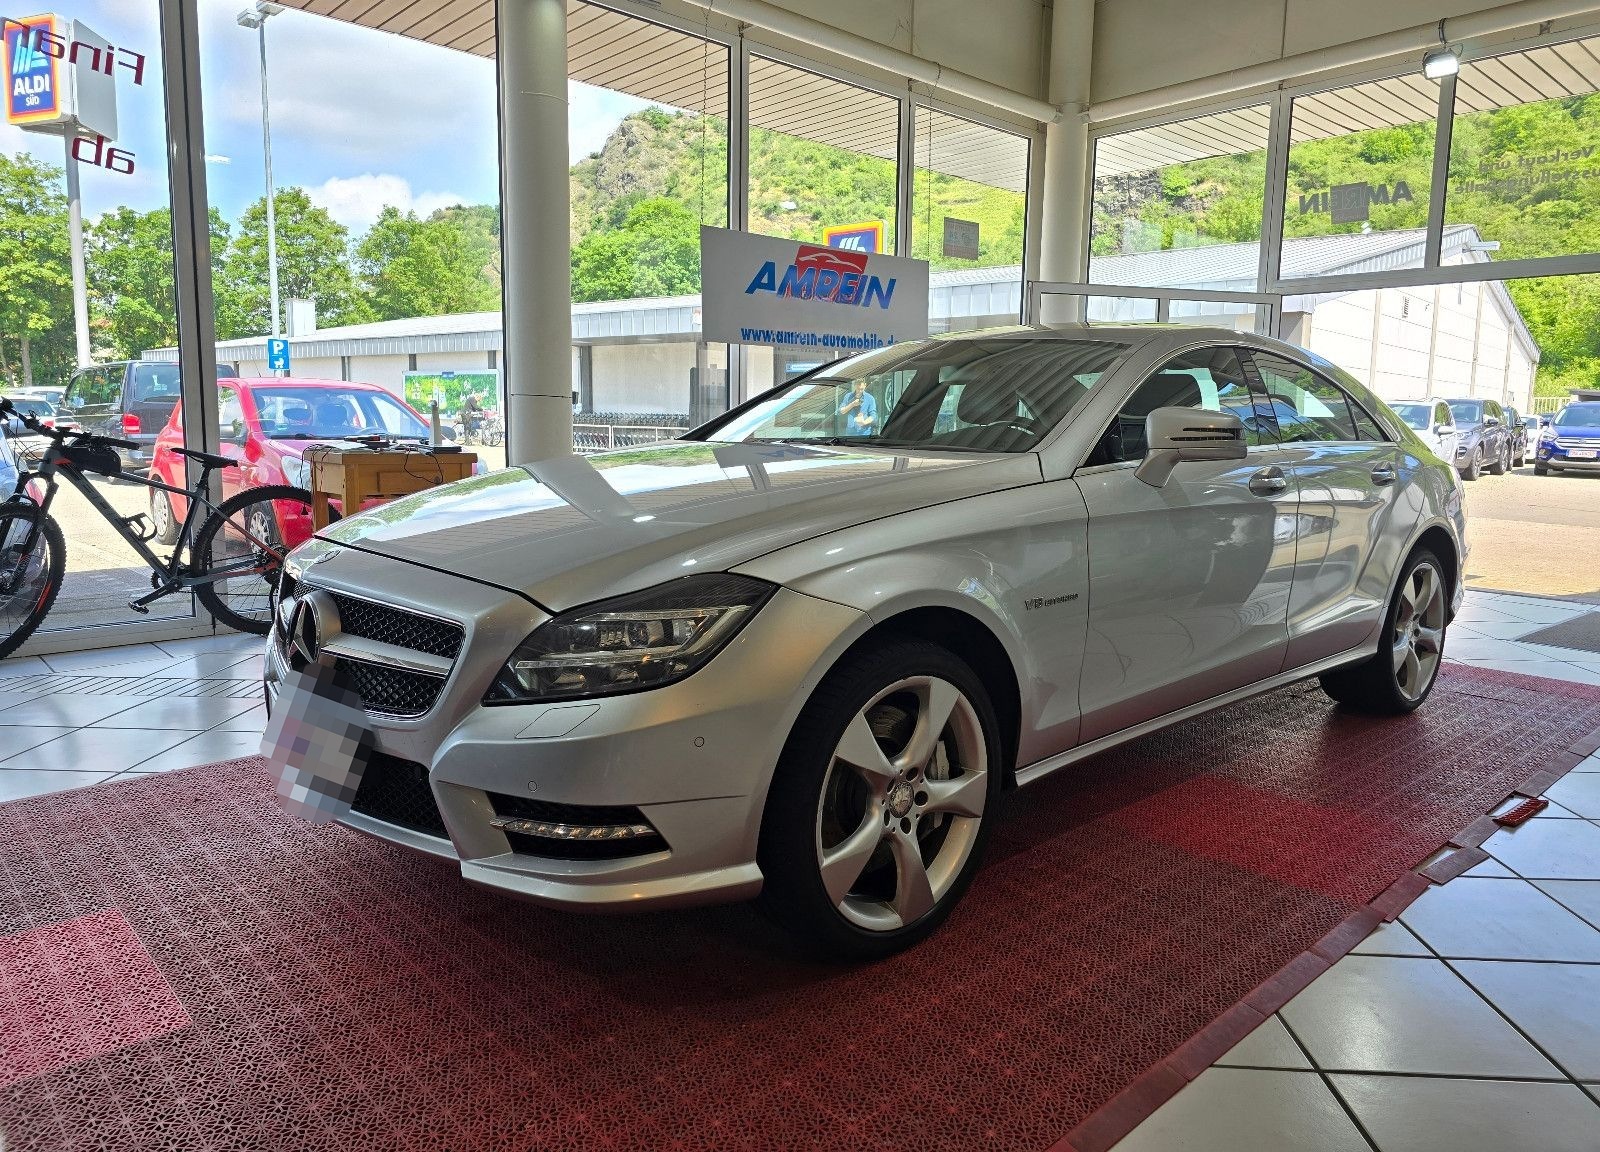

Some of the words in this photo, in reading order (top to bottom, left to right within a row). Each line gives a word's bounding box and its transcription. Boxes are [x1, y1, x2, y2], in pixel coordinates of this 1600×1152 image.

[14, 73, 50, 97] ALDI
[26, 94, 40, 106] SÜD
[745, 261, 897, 309] AMREIN
[273, 340, 284, 355] P
[741, 328, 898, 350] www.amrein-automobile.d
